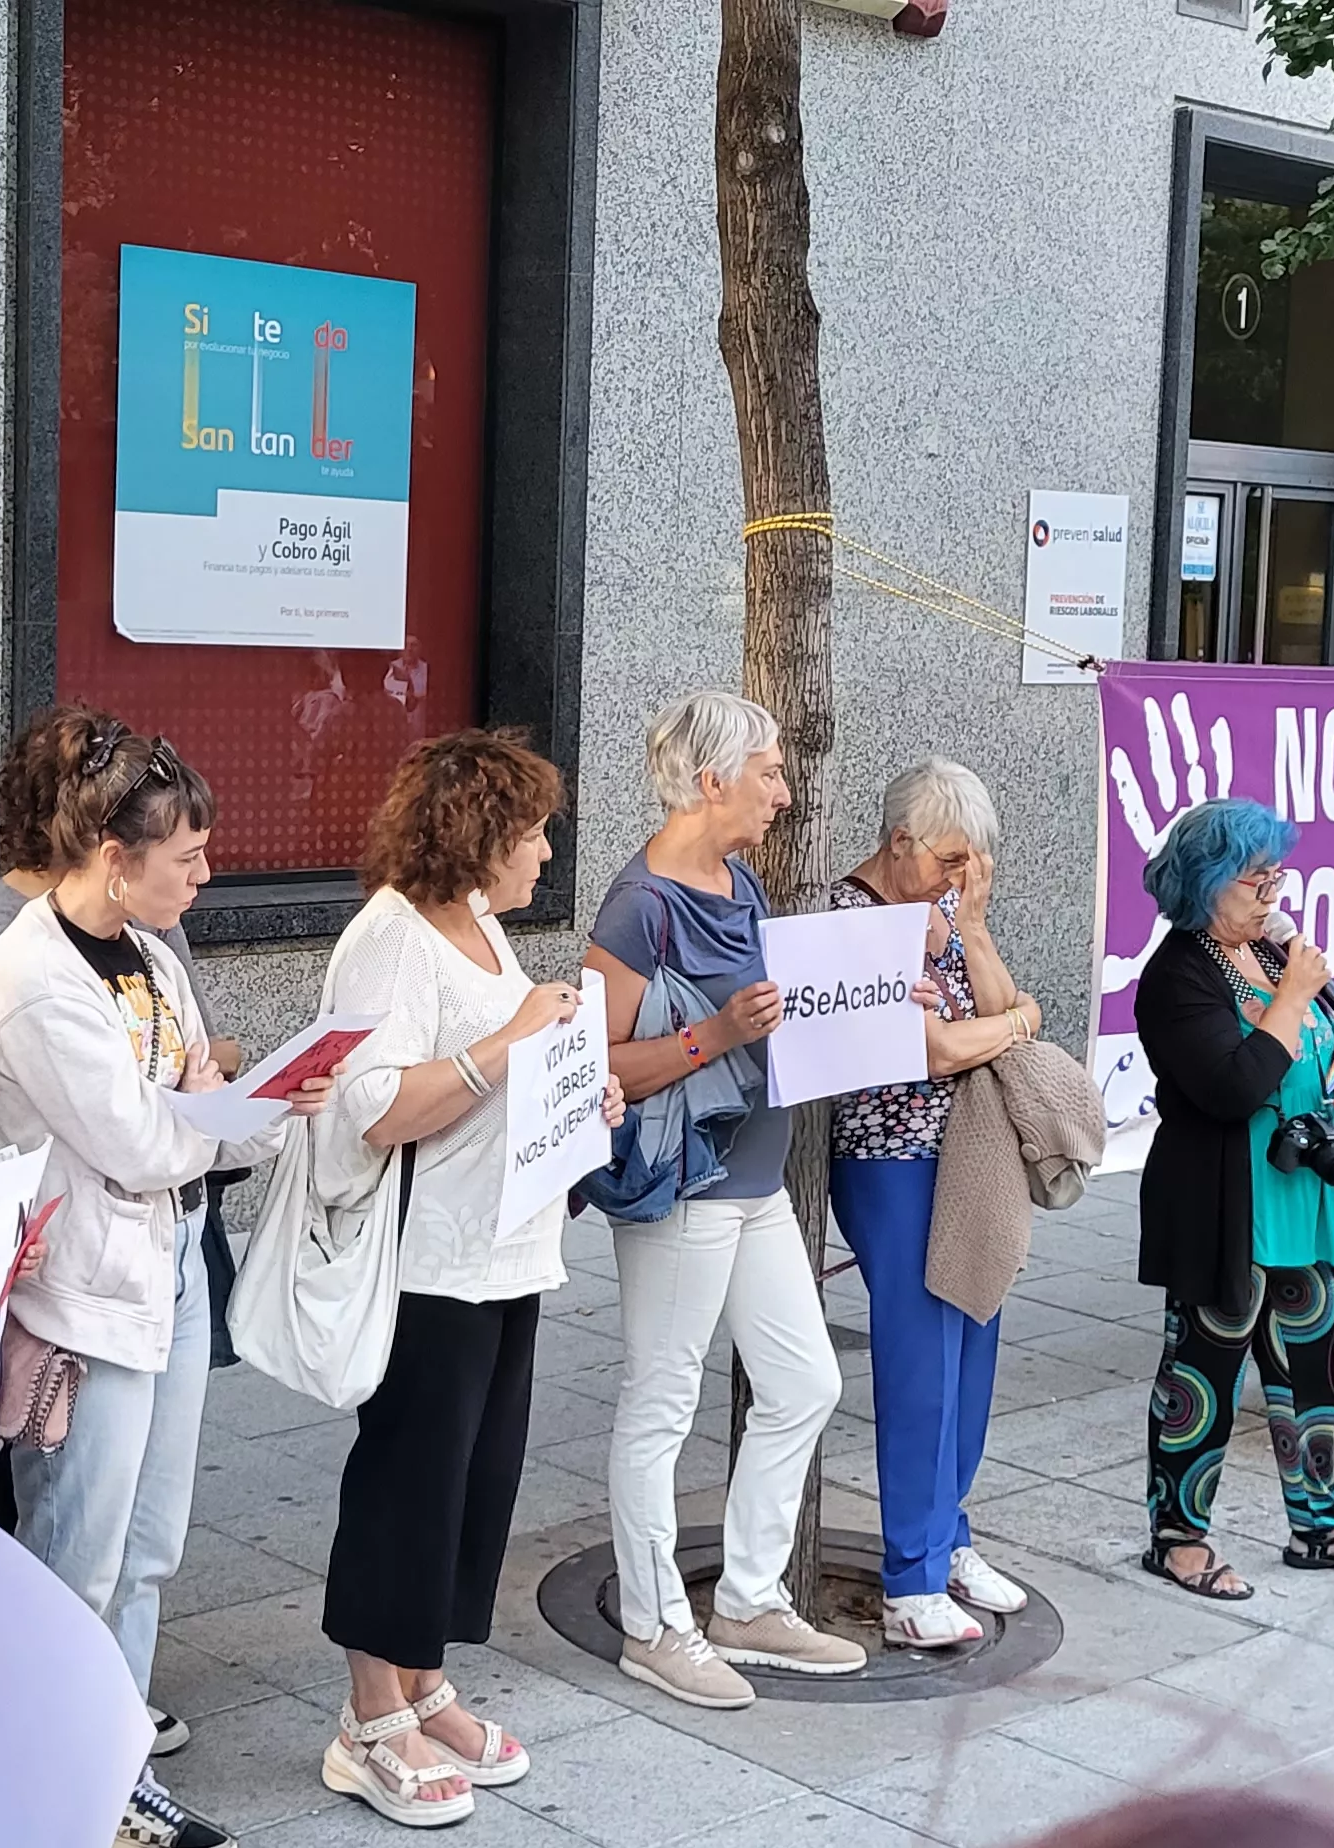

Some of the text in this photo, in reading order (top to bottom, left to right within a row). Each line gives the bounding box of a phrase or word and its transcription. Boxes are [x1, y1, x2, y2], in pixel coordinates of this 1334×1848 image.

[1237, 286, 1248, 330] 1
[183, 303, 349, 352] Si te da
[183, 340, 199, 351] por
[199, 341, 247, 355] evolucionar
[257, 347, 290, 361] negocio
[181, 419, 234, 452] San
[250, 429, 296, 458] tan
[279, 516, 352, 543] Pago Ágil
[258, 540, 351, 566] y Cobro Ágil
[280, 606, 293, 617] Por
[315, 609, 350, 620] primeros
[1049, 592, 1105, 605] PREVENCIÓN DE
[1049, 606, 1119, 617] RIESGOS LABORALES
[782, 970, 908, 1021] #SeAcabó
[544, 1029, 587, 1073] VIVAS
[550, 1060, 597, 1109] LIBRES
[515, 1135, 548, 1173] NOS
